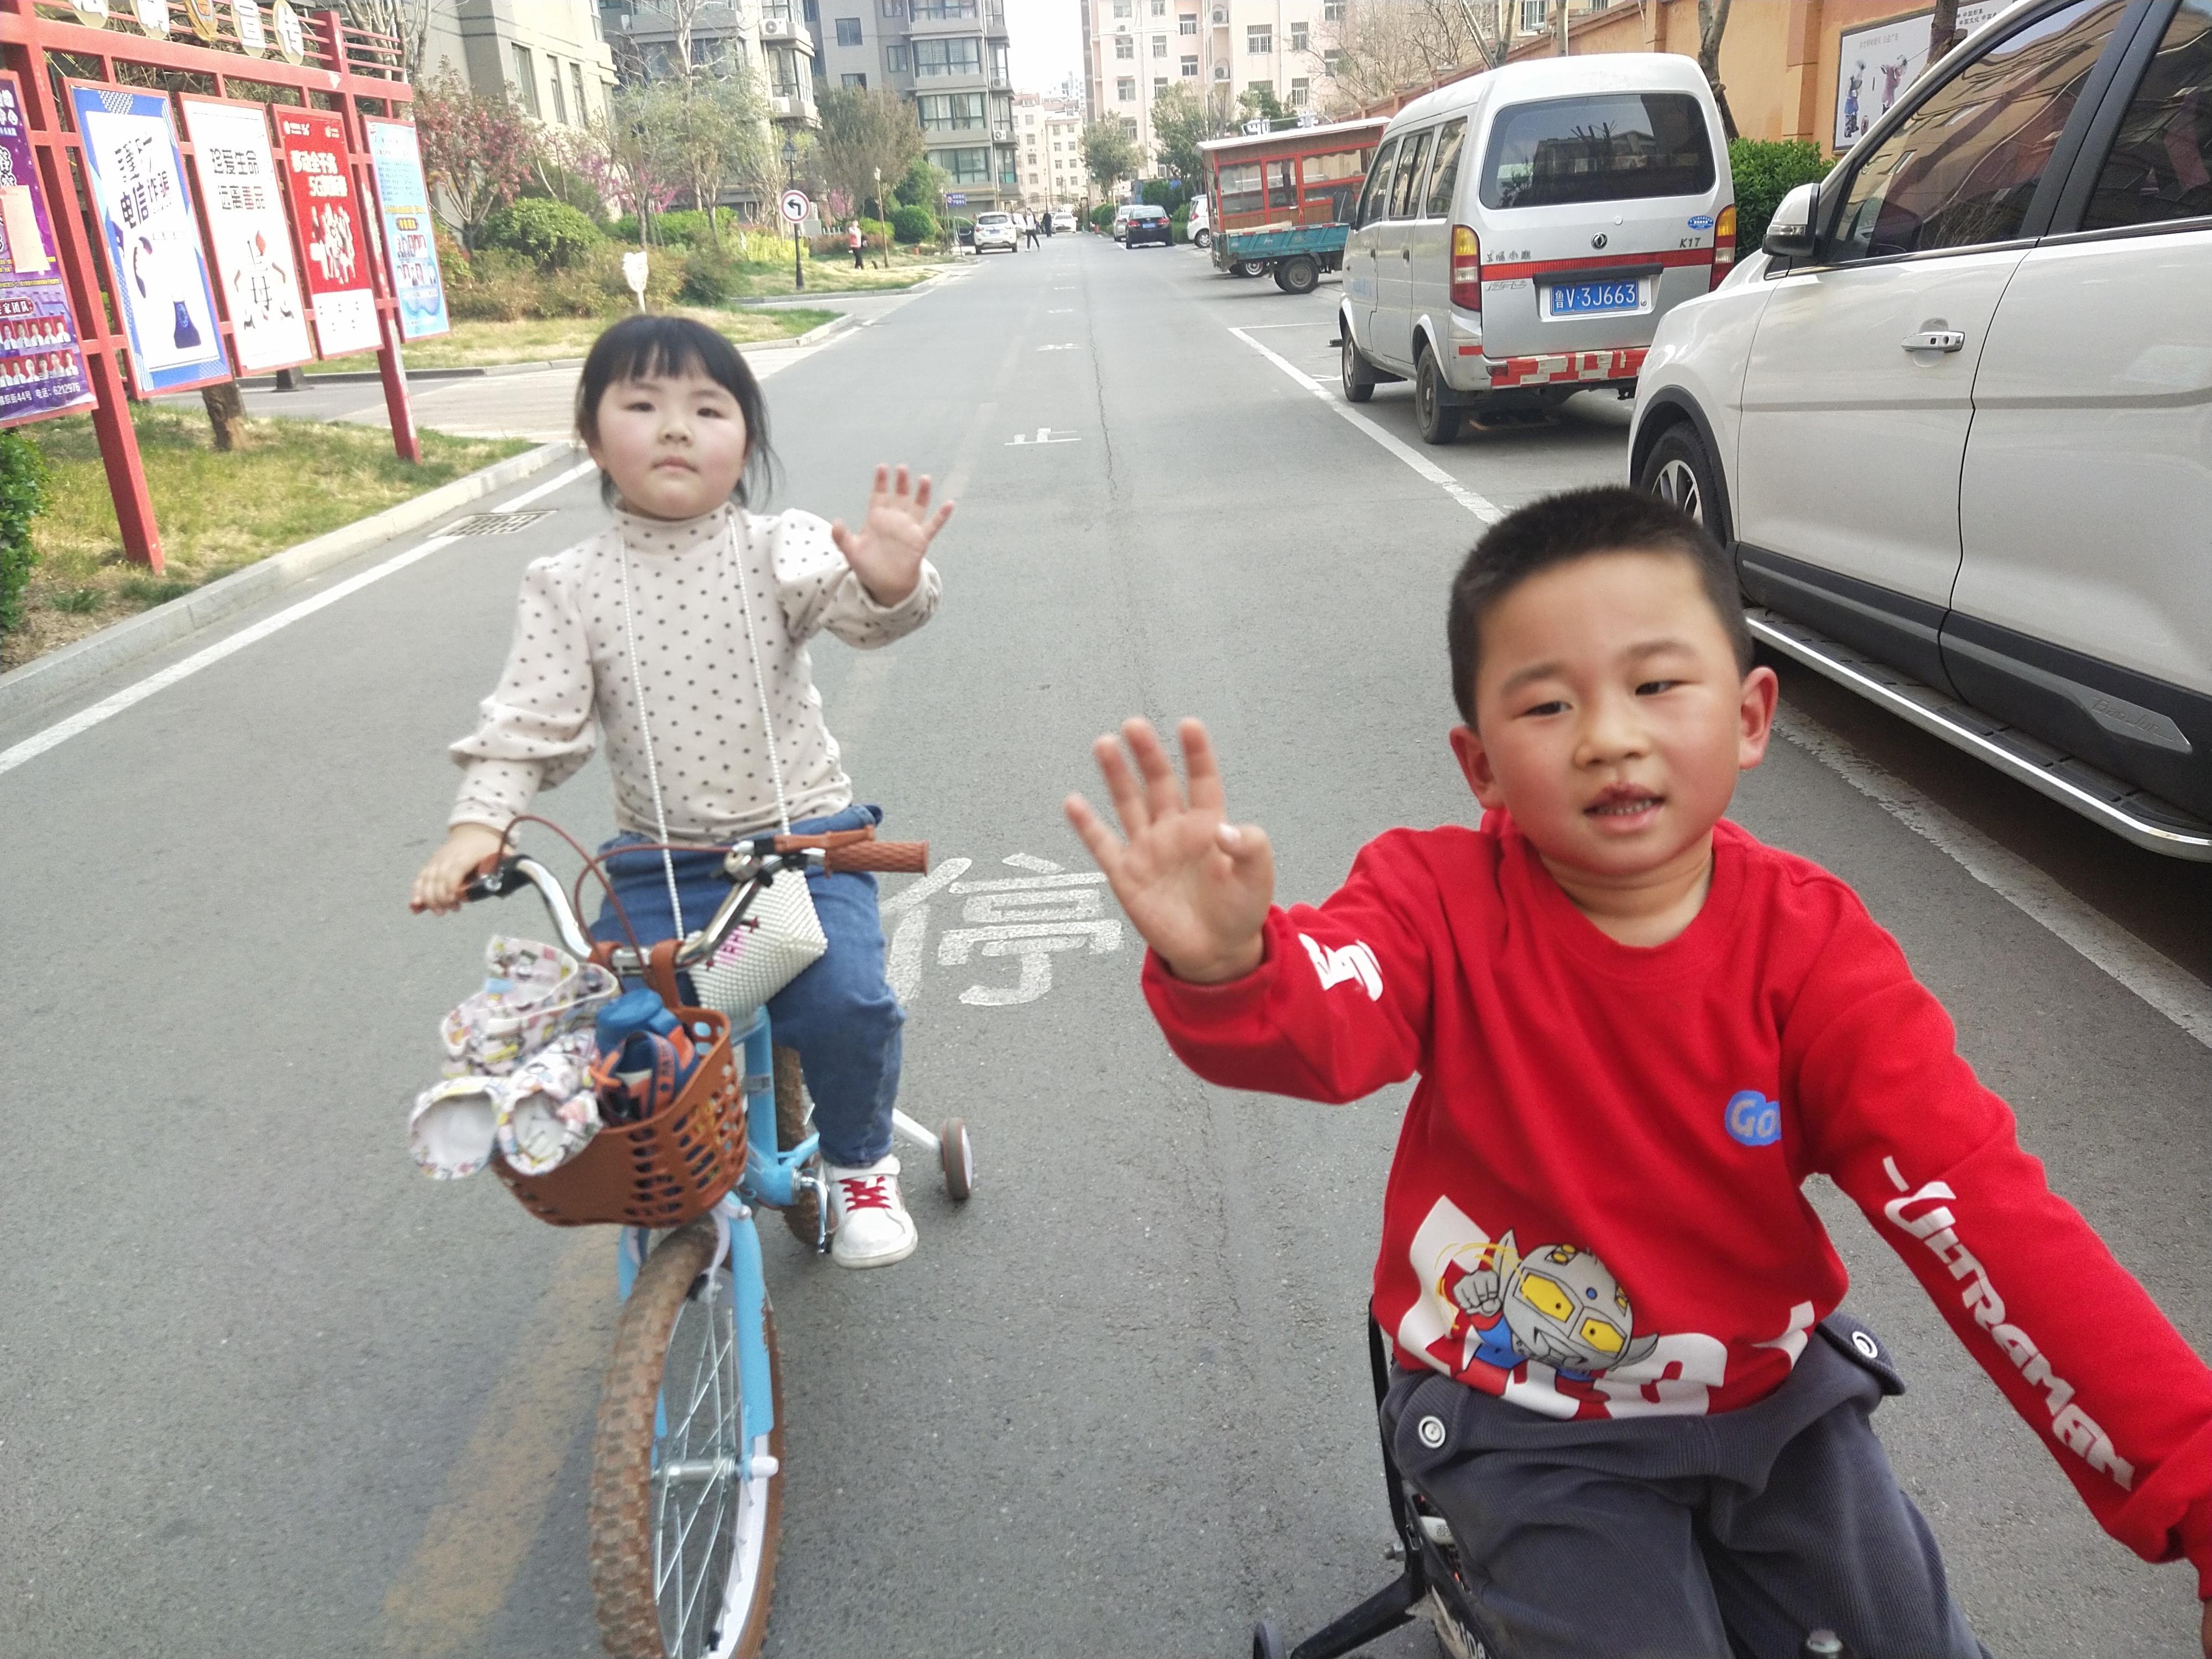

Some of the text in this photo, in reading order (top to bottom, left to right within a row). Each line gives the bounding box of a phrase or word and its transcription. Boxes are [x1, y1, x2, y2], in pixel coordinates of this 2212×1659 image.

[210, 148, 259, 175] 珍爱生命
[120, 170, 170, 229] 电信诈骗
[218, 185, 266, 210] 远离毒品
[1679, 237, 1702, 248] K17
[882, 852, 1123, 1006] 停
